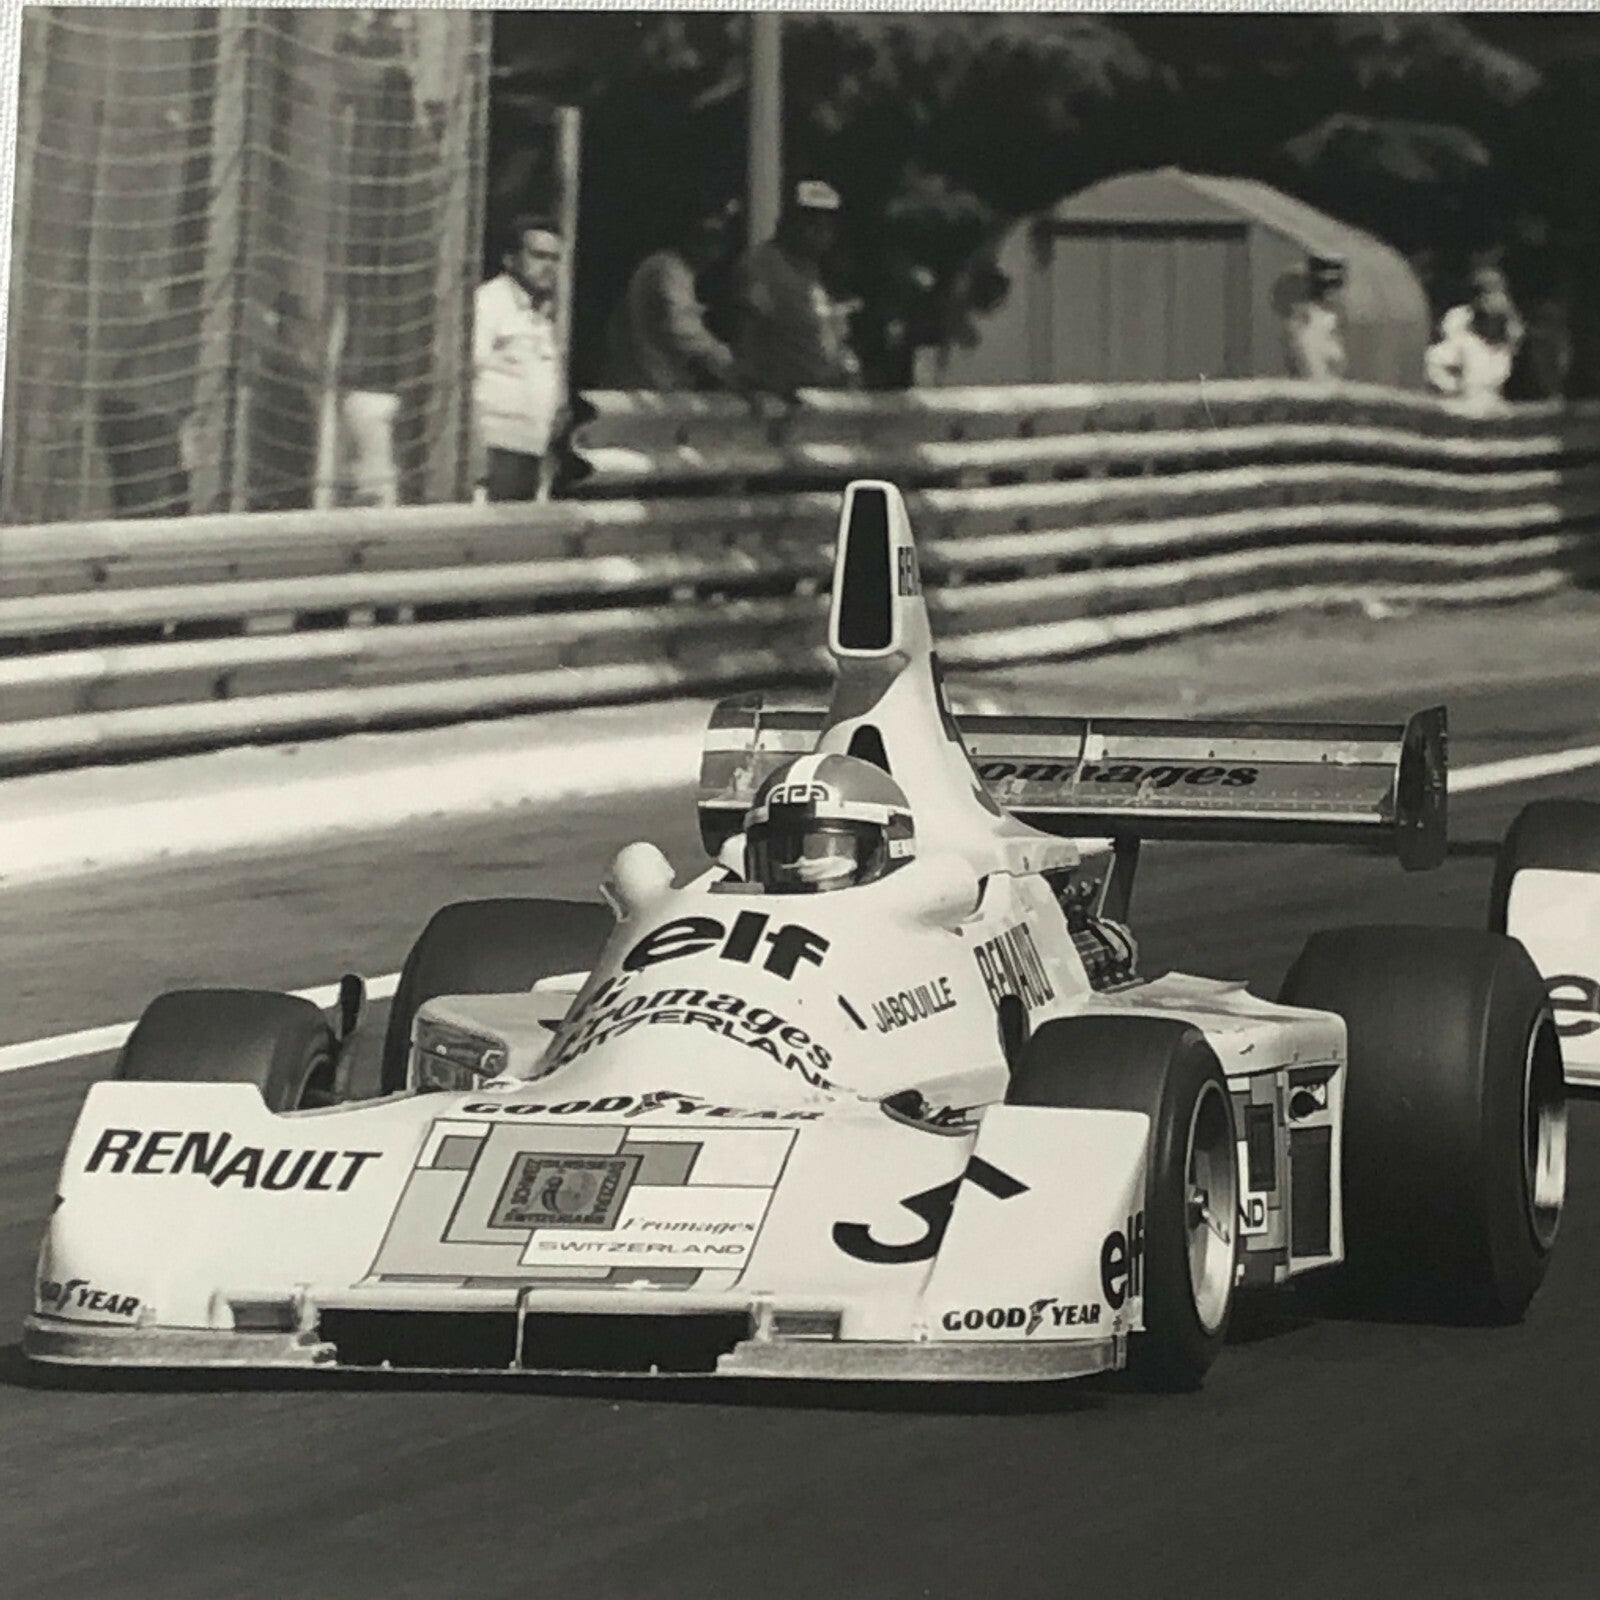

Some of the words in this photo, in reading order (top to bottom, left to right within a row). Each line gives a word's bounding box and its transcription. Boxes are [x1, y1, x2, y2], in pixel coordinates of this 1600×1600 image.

[622, 910, 831, 981] elf
[871, 976, 957, 1033] JABOUILLE
[85, 1129, 382, 1191] RENAULT
[538, 1241, 745, 1255] SWITZERLAND
[1101, 1210, 1145, 1310] elf
